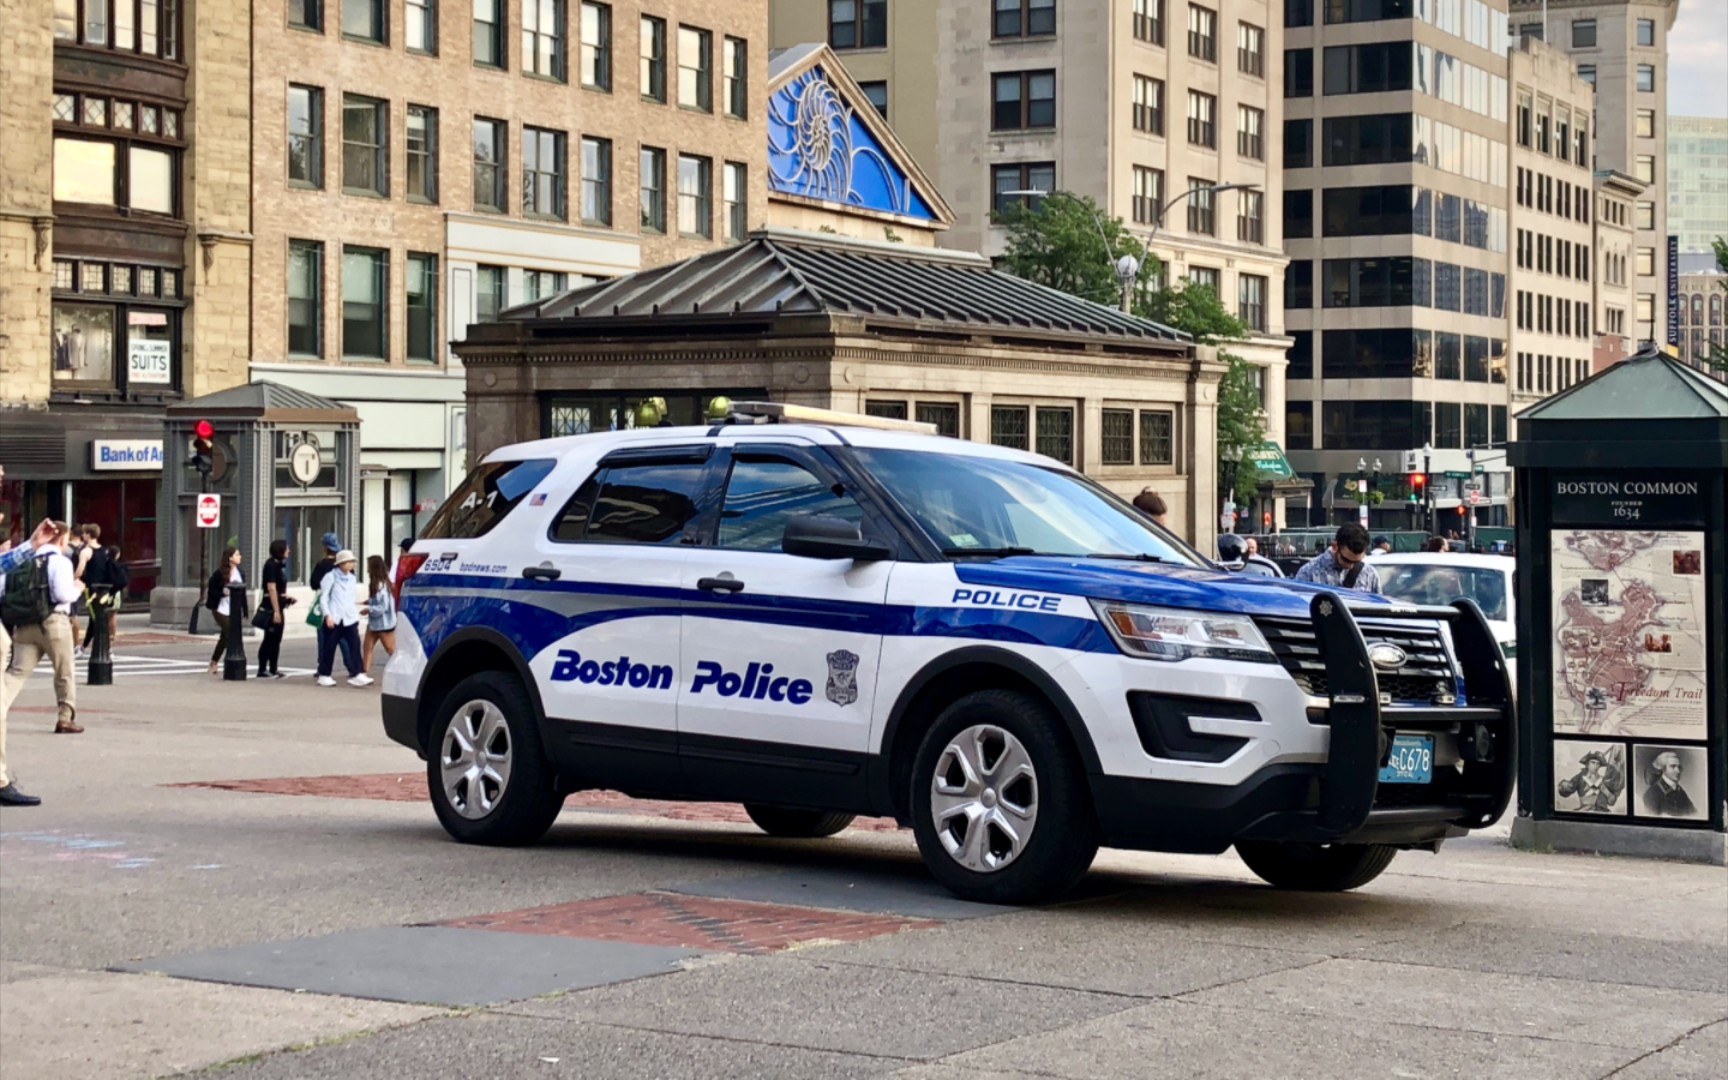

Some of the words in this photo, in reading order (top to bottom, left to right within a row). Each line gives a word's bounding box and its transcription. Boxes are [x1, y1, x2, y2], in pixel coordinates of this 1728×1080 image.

[1669, 240, 1677, 296] UNIVERSITY
[1668, 298, 1677, 342] SUFFOLK
[131, 354, 167, 371] SUITS
[101, 446, 134, 462] Bank
[136, 446, 149, 462] of
[1557, 482, 1619, 494] BOSTON
[1623, 482, 1698, 494] COMMON
[459, 490, 498, 510] A-1
[1613, 506, 1640, 520] 1634
[424, 559, 452, 571] 6504
[459, 561, 507, 573] bpdnews.com
[951, 588, 1062, 612] POLICE
[551, 649, 673, 690] Boston
[690, 660, 813, 705] Police
[1674, 687, 1703, 700] Trail
[1400, 747, 1430, 772] C678
